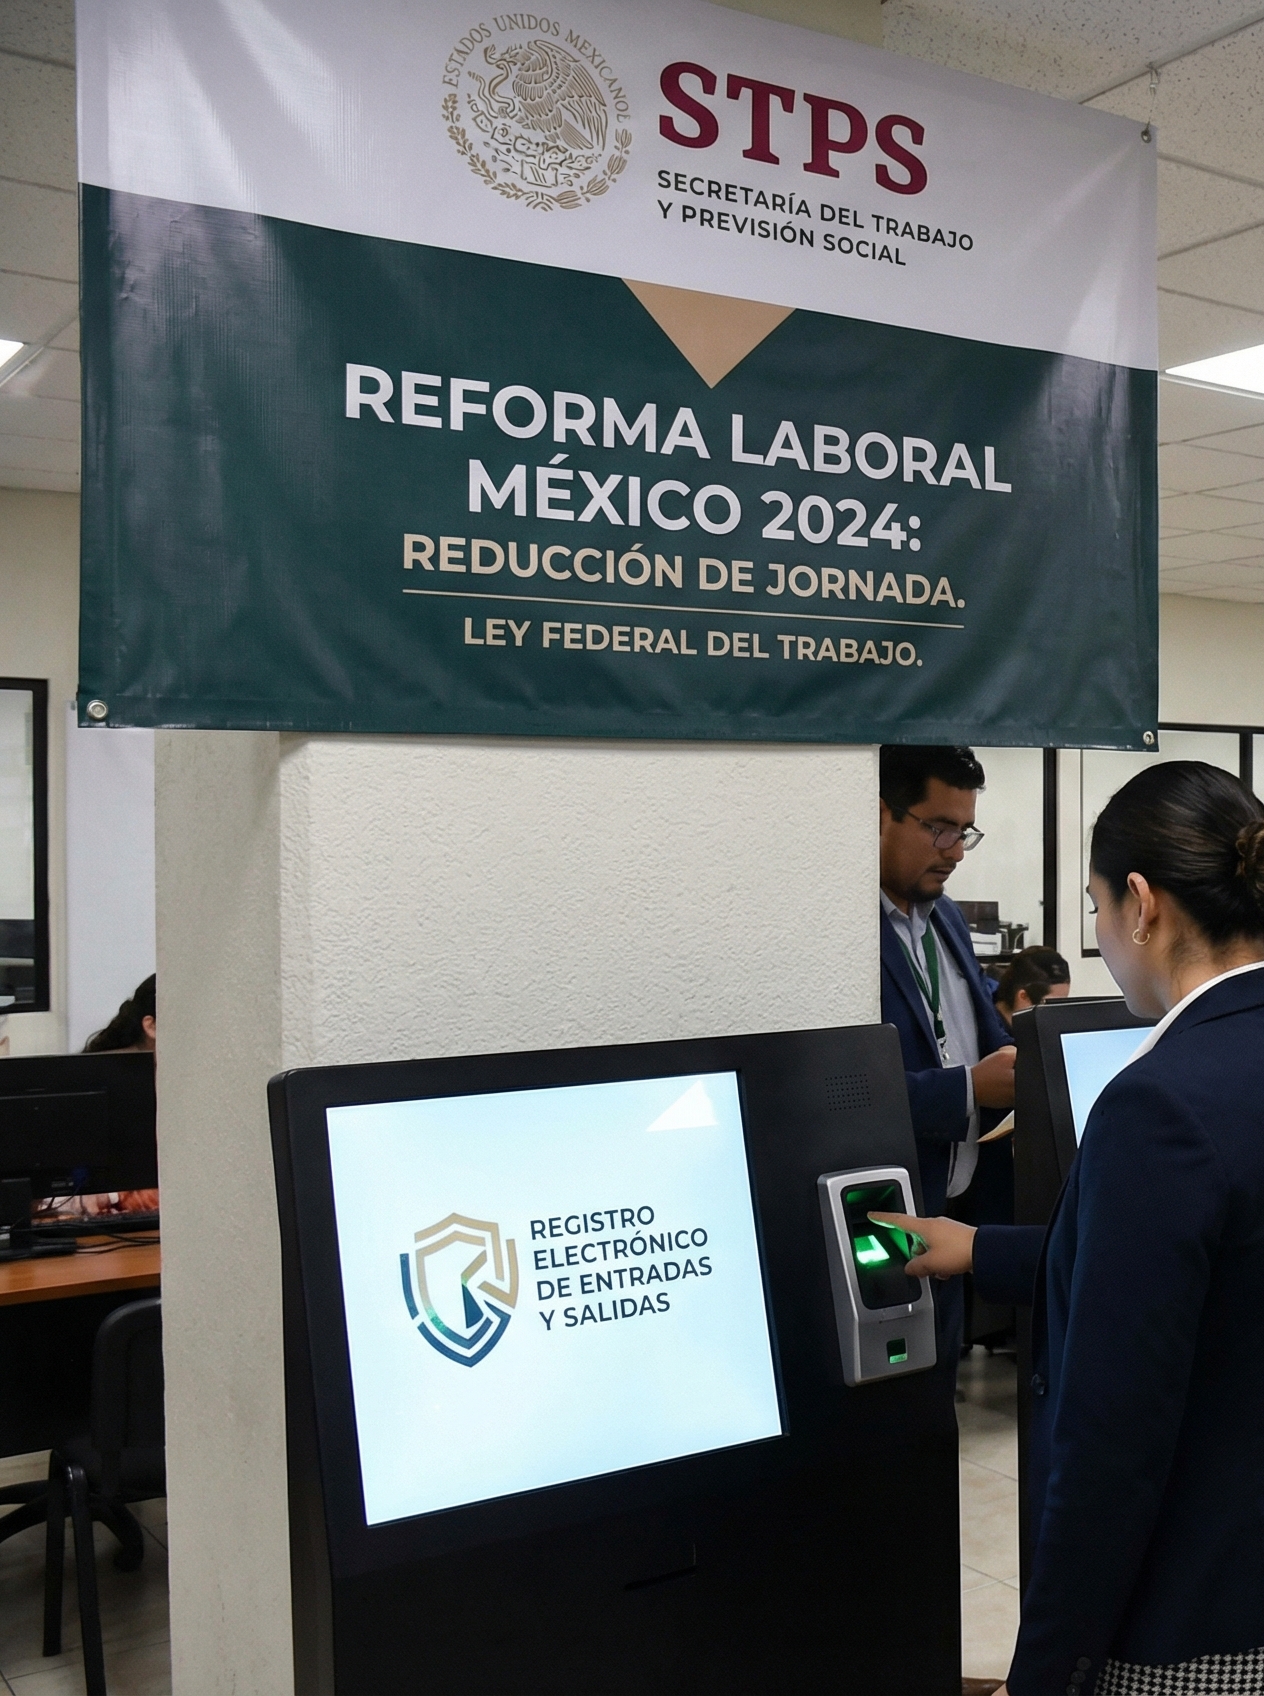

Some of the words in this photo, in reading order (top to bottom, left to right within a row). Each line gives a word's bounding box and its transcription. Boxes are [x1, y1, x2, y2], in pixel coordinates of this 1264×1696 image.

[443, 23, 491, 88] ESTADOS
[493, 13, 560, 37] UNIDOS
[659, 61, 928, 195] STPS
[657, 169, 811, 218] SECRETARÍA
[820, 203, 864, 229] DEL
[871, 214, 974, 251] TRABAJO
[657, 199, 673, 219] Y
[682, 204, 814, 247] PREVISIÓN
[823, 233, 906, 266] SOCIAL
[345, 362, 710, 460] REFORMA
[730, 413, 1012, 493] LABORAL
[468, 453, 742, 536] MÉXICO
[761, 490, 922, 552] 2024:
[402, 533, 682, 589] REDUCCIÓN
[699, 557, 755, 593] DE
[766, 562, 966, 608] JORNADA.
[464, 616, 532, 647] LEY
[542, 621, 698, 655] FEDERAL
[707, 630, 769, 659] DEL
[777, 634, 923, 667] TRABAJO.
[530, 1205, 655, 1240] REGISTRO
[534, 1228, 708, 1270] ELECTRÓNICO
[537, 1277, 572, 1301] DE
[580, 1256, 713, 1295] ENTRADAS
[539, 1310, 556, 1331] Y
[564, 1292, 671, 1327] SALIDAS
